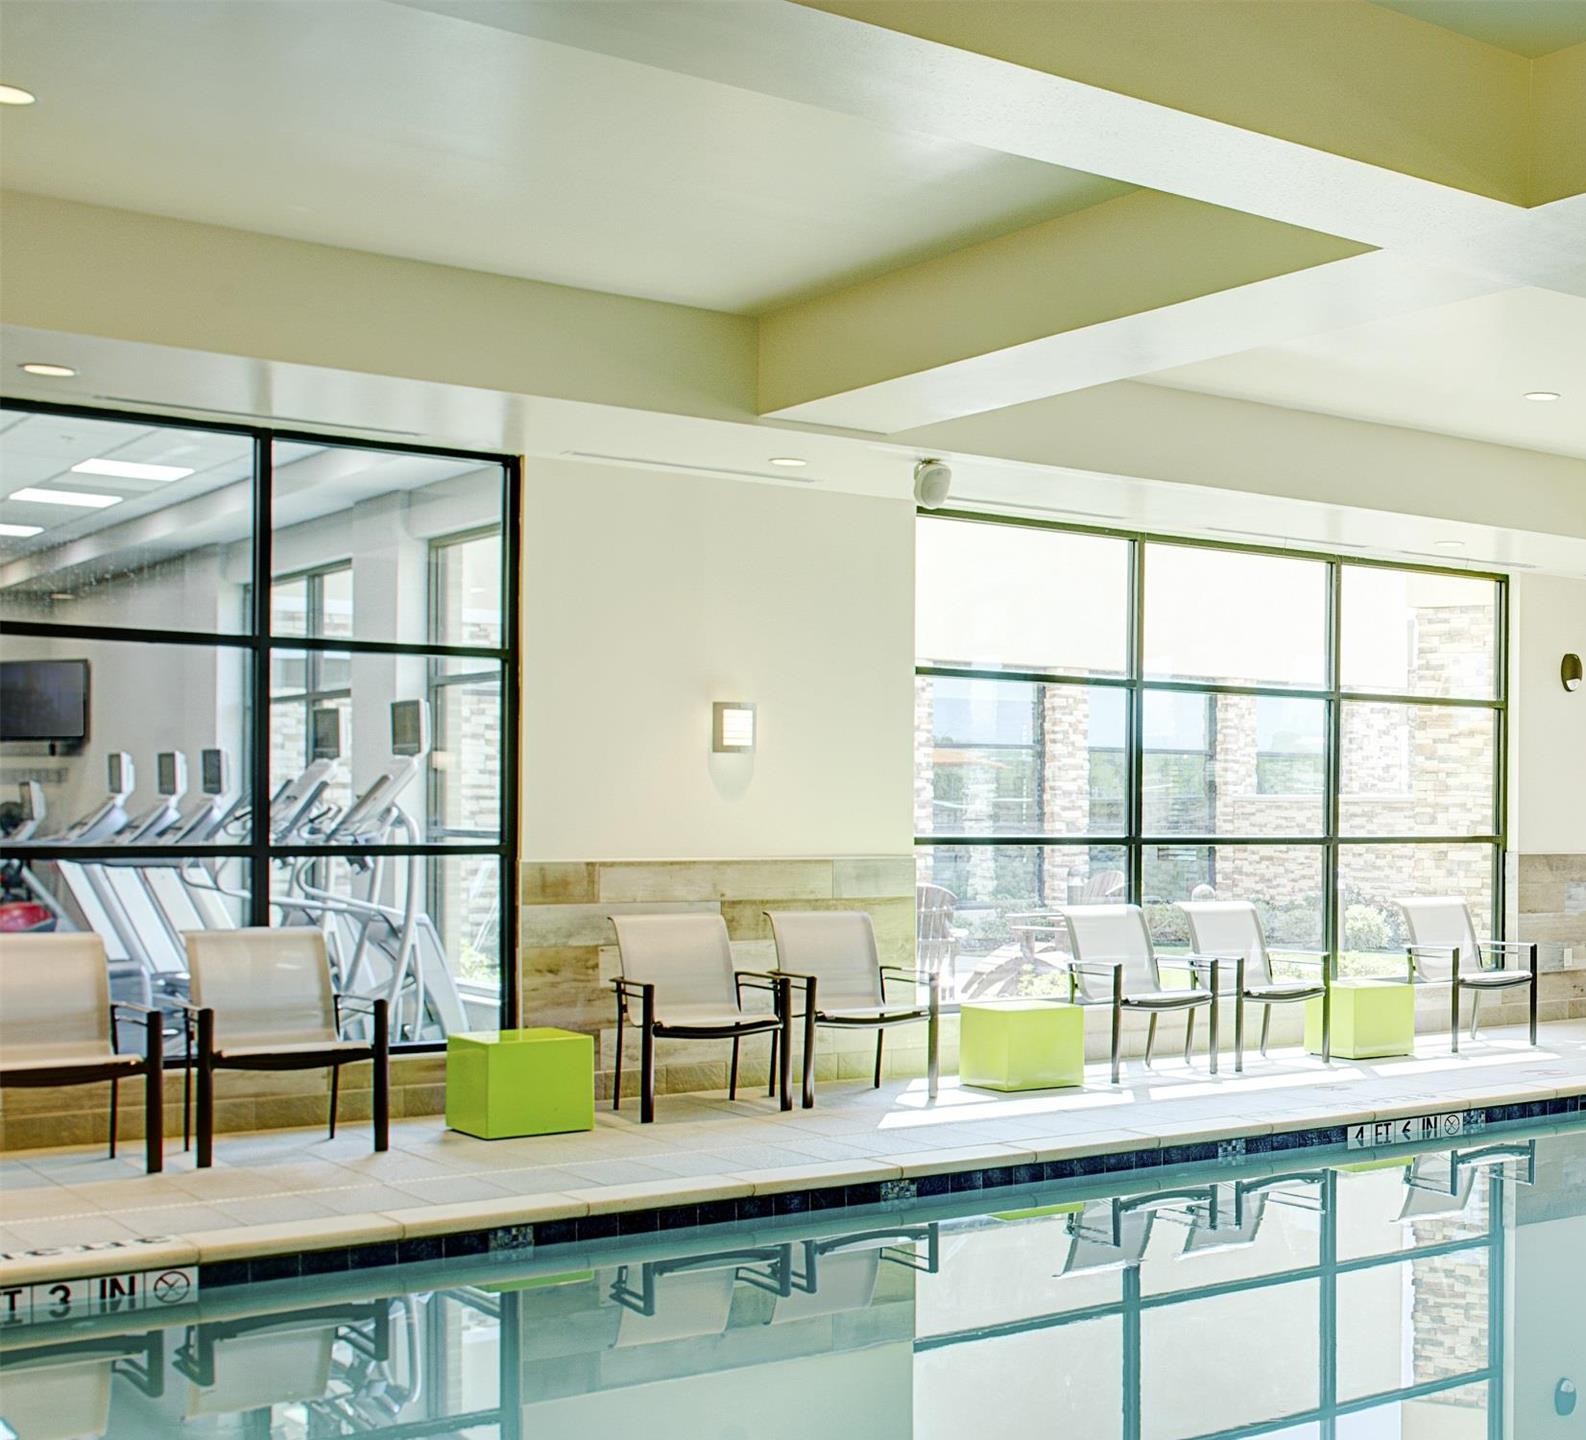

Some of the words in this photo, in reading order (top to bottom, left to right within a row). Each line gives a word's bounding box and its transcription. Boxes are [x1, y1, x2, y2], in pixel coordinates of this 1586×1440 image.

[1422, 1116, 1438, 1131] IN
[0, 1289, 23, 1312] T
[99, 1275, 136, 1300] IN
